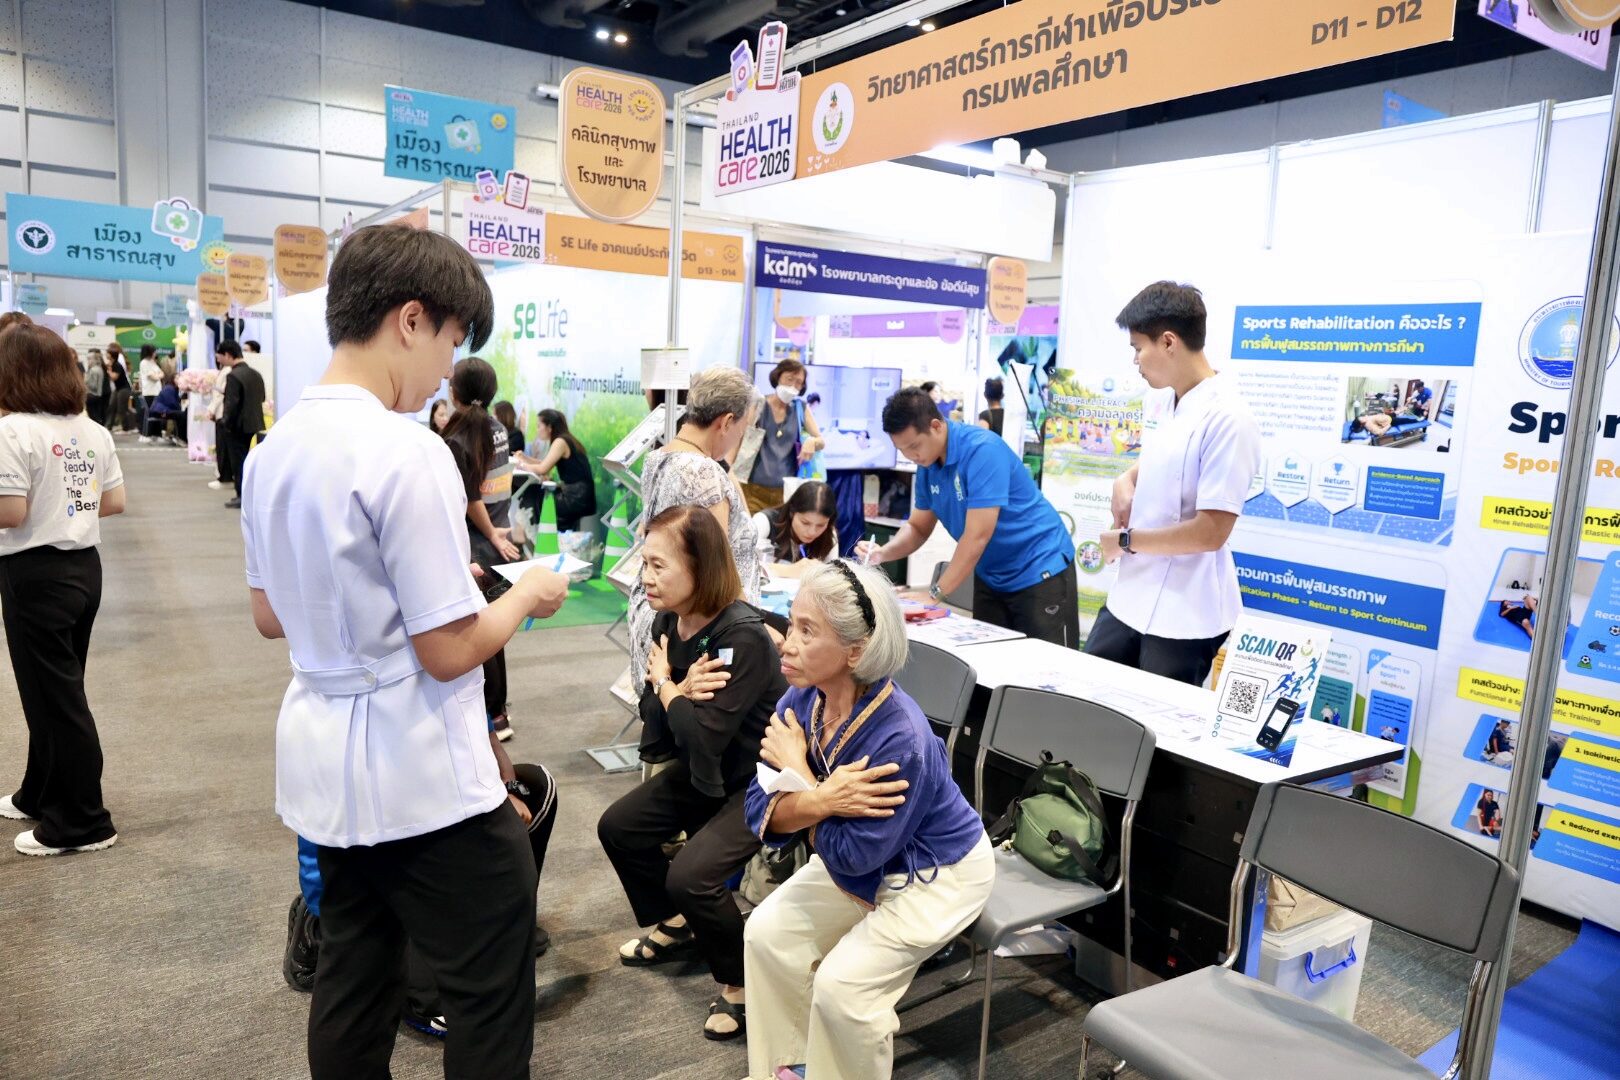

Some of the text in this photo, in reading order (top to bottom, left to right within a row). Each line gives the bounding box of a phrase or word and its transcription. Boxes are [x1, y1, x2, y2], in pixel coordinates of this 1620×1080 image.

[1311, 16, 1348, 45] D11
[1376, 0, 1422, 30] D12
[962, 48, 1129, 112] กรมพลศึกษา
[576, 85, 622, 104] HEALTH
[576, 96, 602, 110] care
[603, 102, 622, 114] 2026
[722, 111, 759, 131] THAILAND
[395, 129, 441, 155] เมือง
[571, 125, 656, 154] คลินิกสุขภาพ
[720, 114, 792, 162] HEALTH
[604, 155, 624, 168] และ
[718, 148, 790, 187] care 2026
[577, 165, 647, 192] โรงพยาบาล
[469, 212, 509, 223] THAILAND
[93, 222, 142, 244] เมือง
[469, 219, 541, 245] HEALTH
[468, 238, 541, 260] care 2026
[560, 235, 575, 249] SE
[577, 238, 598, 253] Life
[66, 243, 176, 271] สาธารณสุข
[821, 264, 938, 290] โรงพยาบาลกระดูกและข้อ
[1242, 313, 1467, 331] Sports Rehabilitation คืออะไร ?
[1241, 333, 1424, 354] การฟื้นฟูสมรรถภาพทางการกีฬา
[1508, 401, 1620, 443] Spr
[64, 448, 81, 459] Get
[72, 475, 89, 486] For
[1277, 471, 1305, 480] Restore
[1324, 476, 1350, 485] Return
[66, 487, 82, 498] The
[1585, 529, 1611, 538] Elastic
[1272, 591, 1300, 605] Phases
[1308, 599, 1337, 613] Return
[1339, 606, 1349, 615] to
[1350, 607, 1375, 621] Sport
[1376, 613, 1428, 632] Continuum
[1236, 634, 1298, 661] SCAN QR
[1470, 689, 1507, 703] Functional
[1569, 711, 1602, 726] Training
[1568, 821, 1600, 836] Redcord
